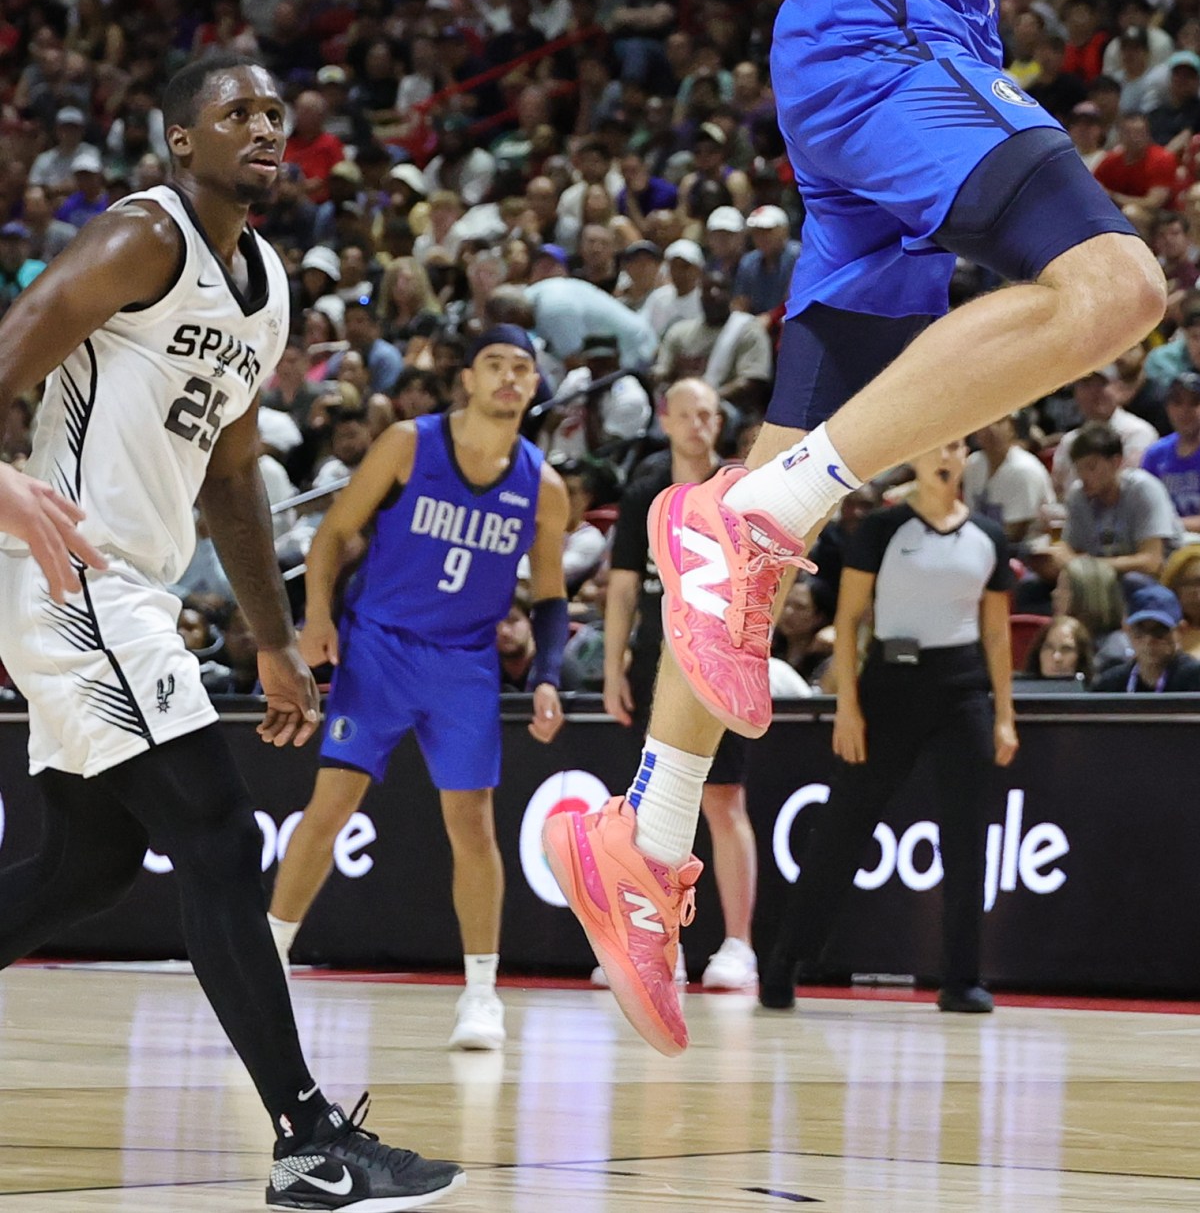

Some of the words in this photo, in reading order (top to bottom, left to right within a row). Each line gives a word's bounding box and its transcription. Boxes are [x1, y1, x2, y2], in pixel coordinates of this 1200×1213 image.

[164, 375, 230, 453] 25
[410, 495, 523, 555] DALLAS
[437, 546, 473, 594] 9
